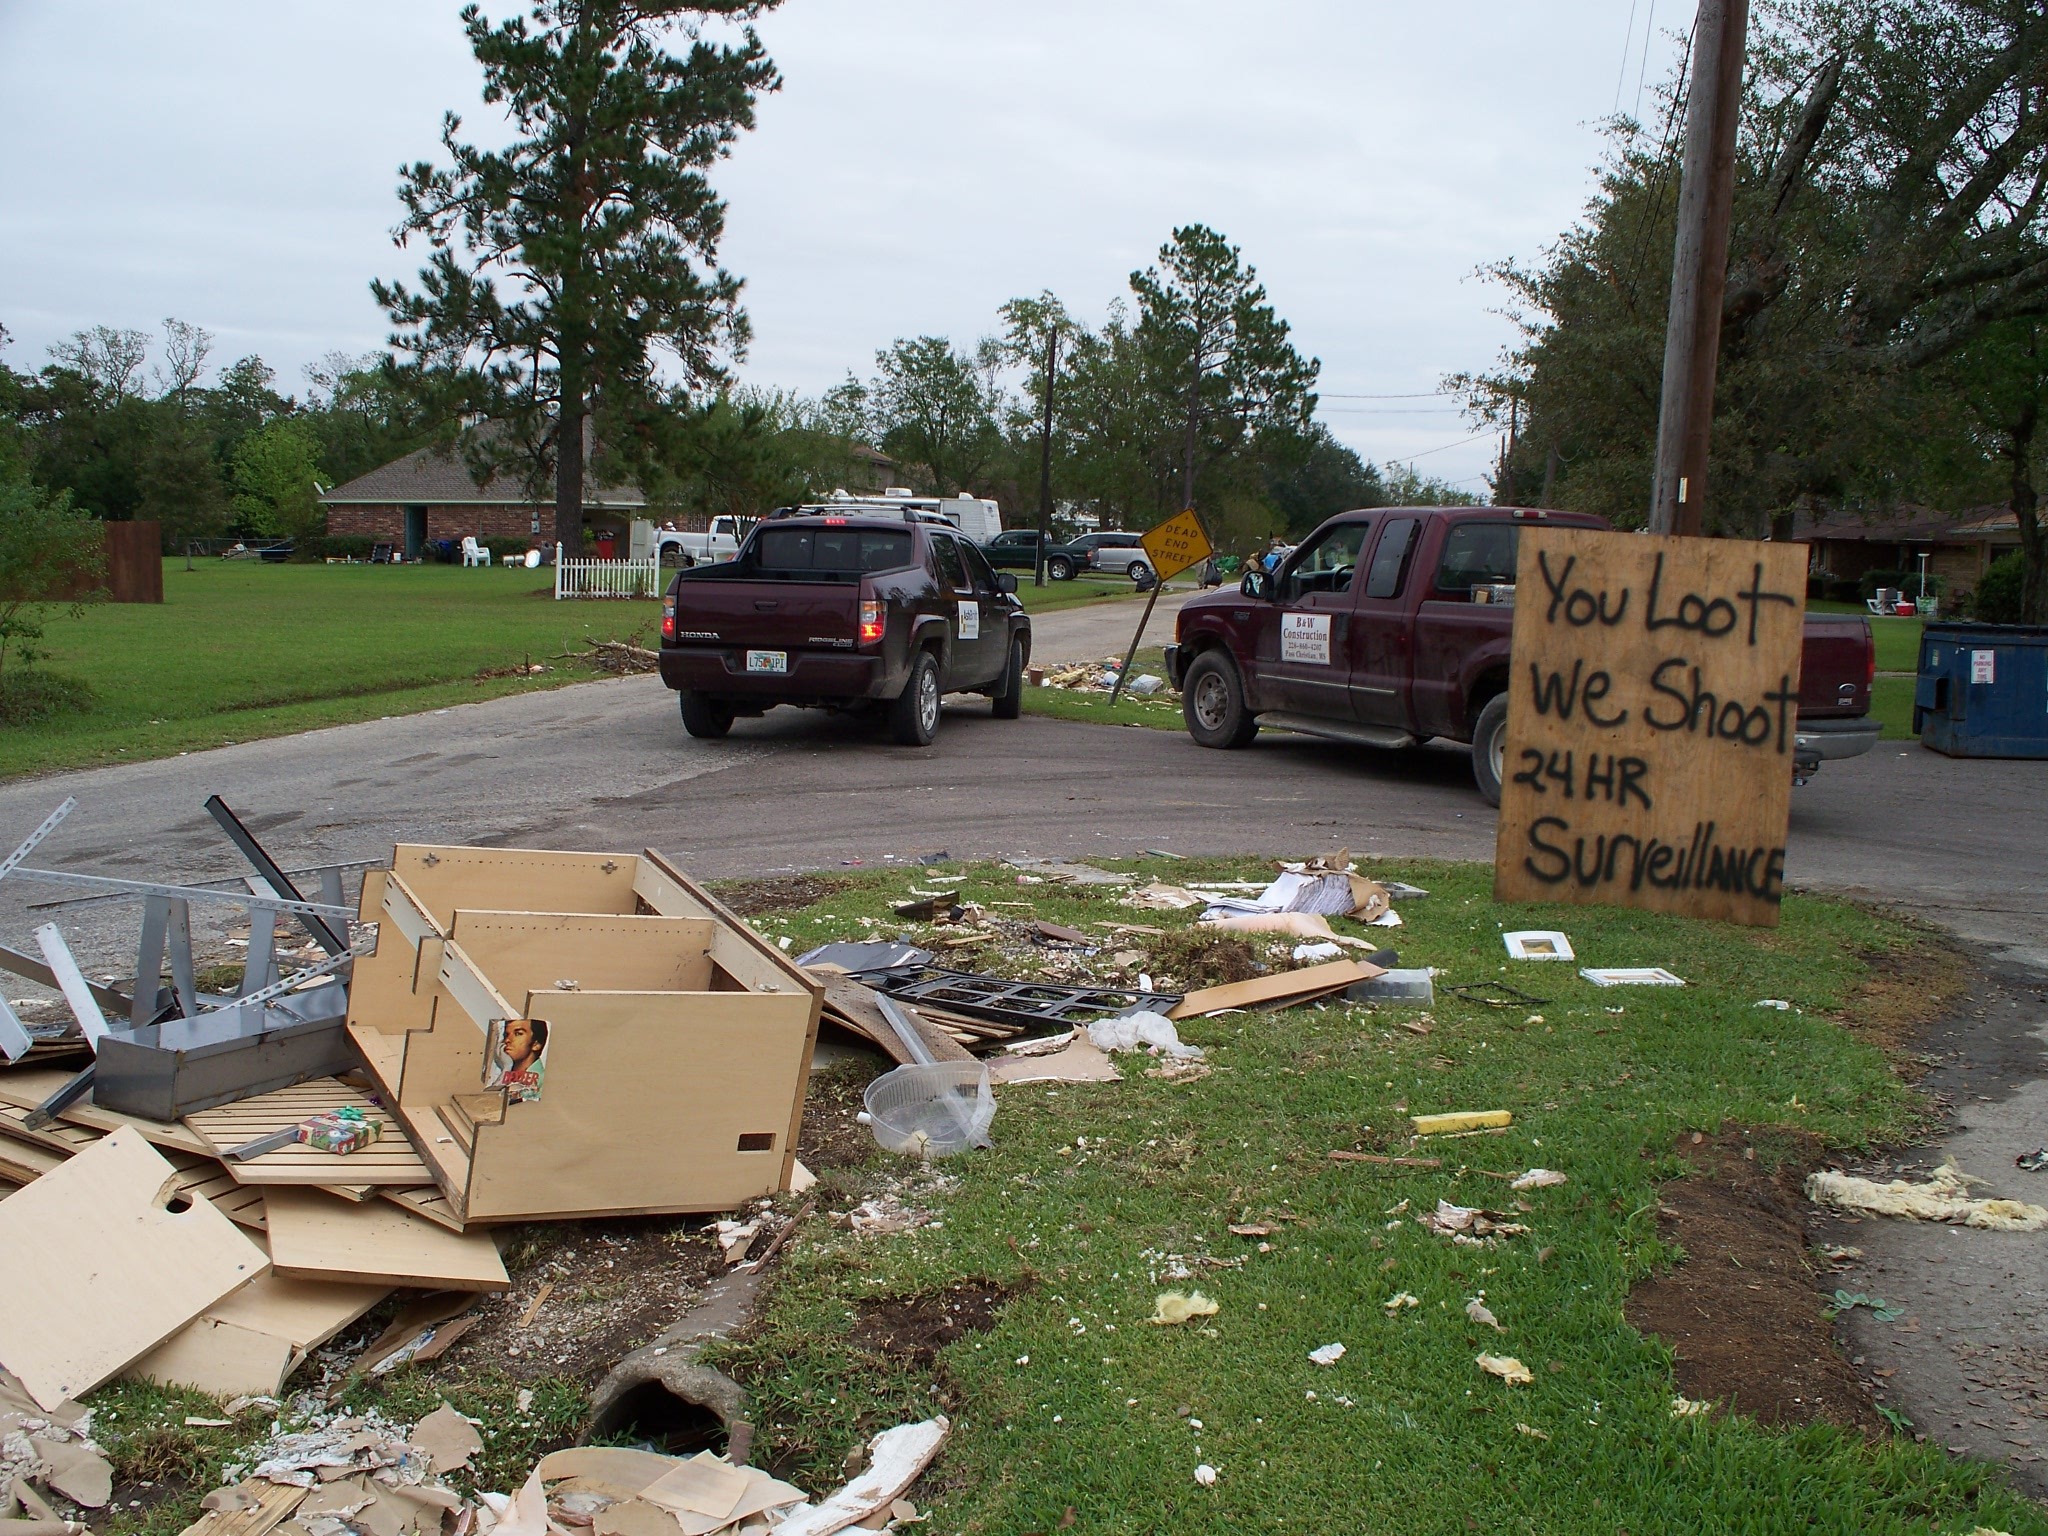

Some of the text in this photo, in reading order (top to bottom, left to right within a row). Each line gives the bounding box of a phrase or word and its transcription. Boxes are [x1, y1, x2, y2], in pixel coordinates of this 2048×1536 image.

[1165, 524, 1198, 538] DEAD
[1164, 538, 1189, 550] END
[1152, 549, 1194, 564] STREET
[1537, 550, 1796, 647] You Loot
[680, 631, 720, 639] HONDA
[808, 636, 854, 644] RIDGELINE
[1283, 627, 1328, 642] Construction
[1529, 658, 1800, 755] We Shoot
[1512, 749, 1652, 811] 24 HR
